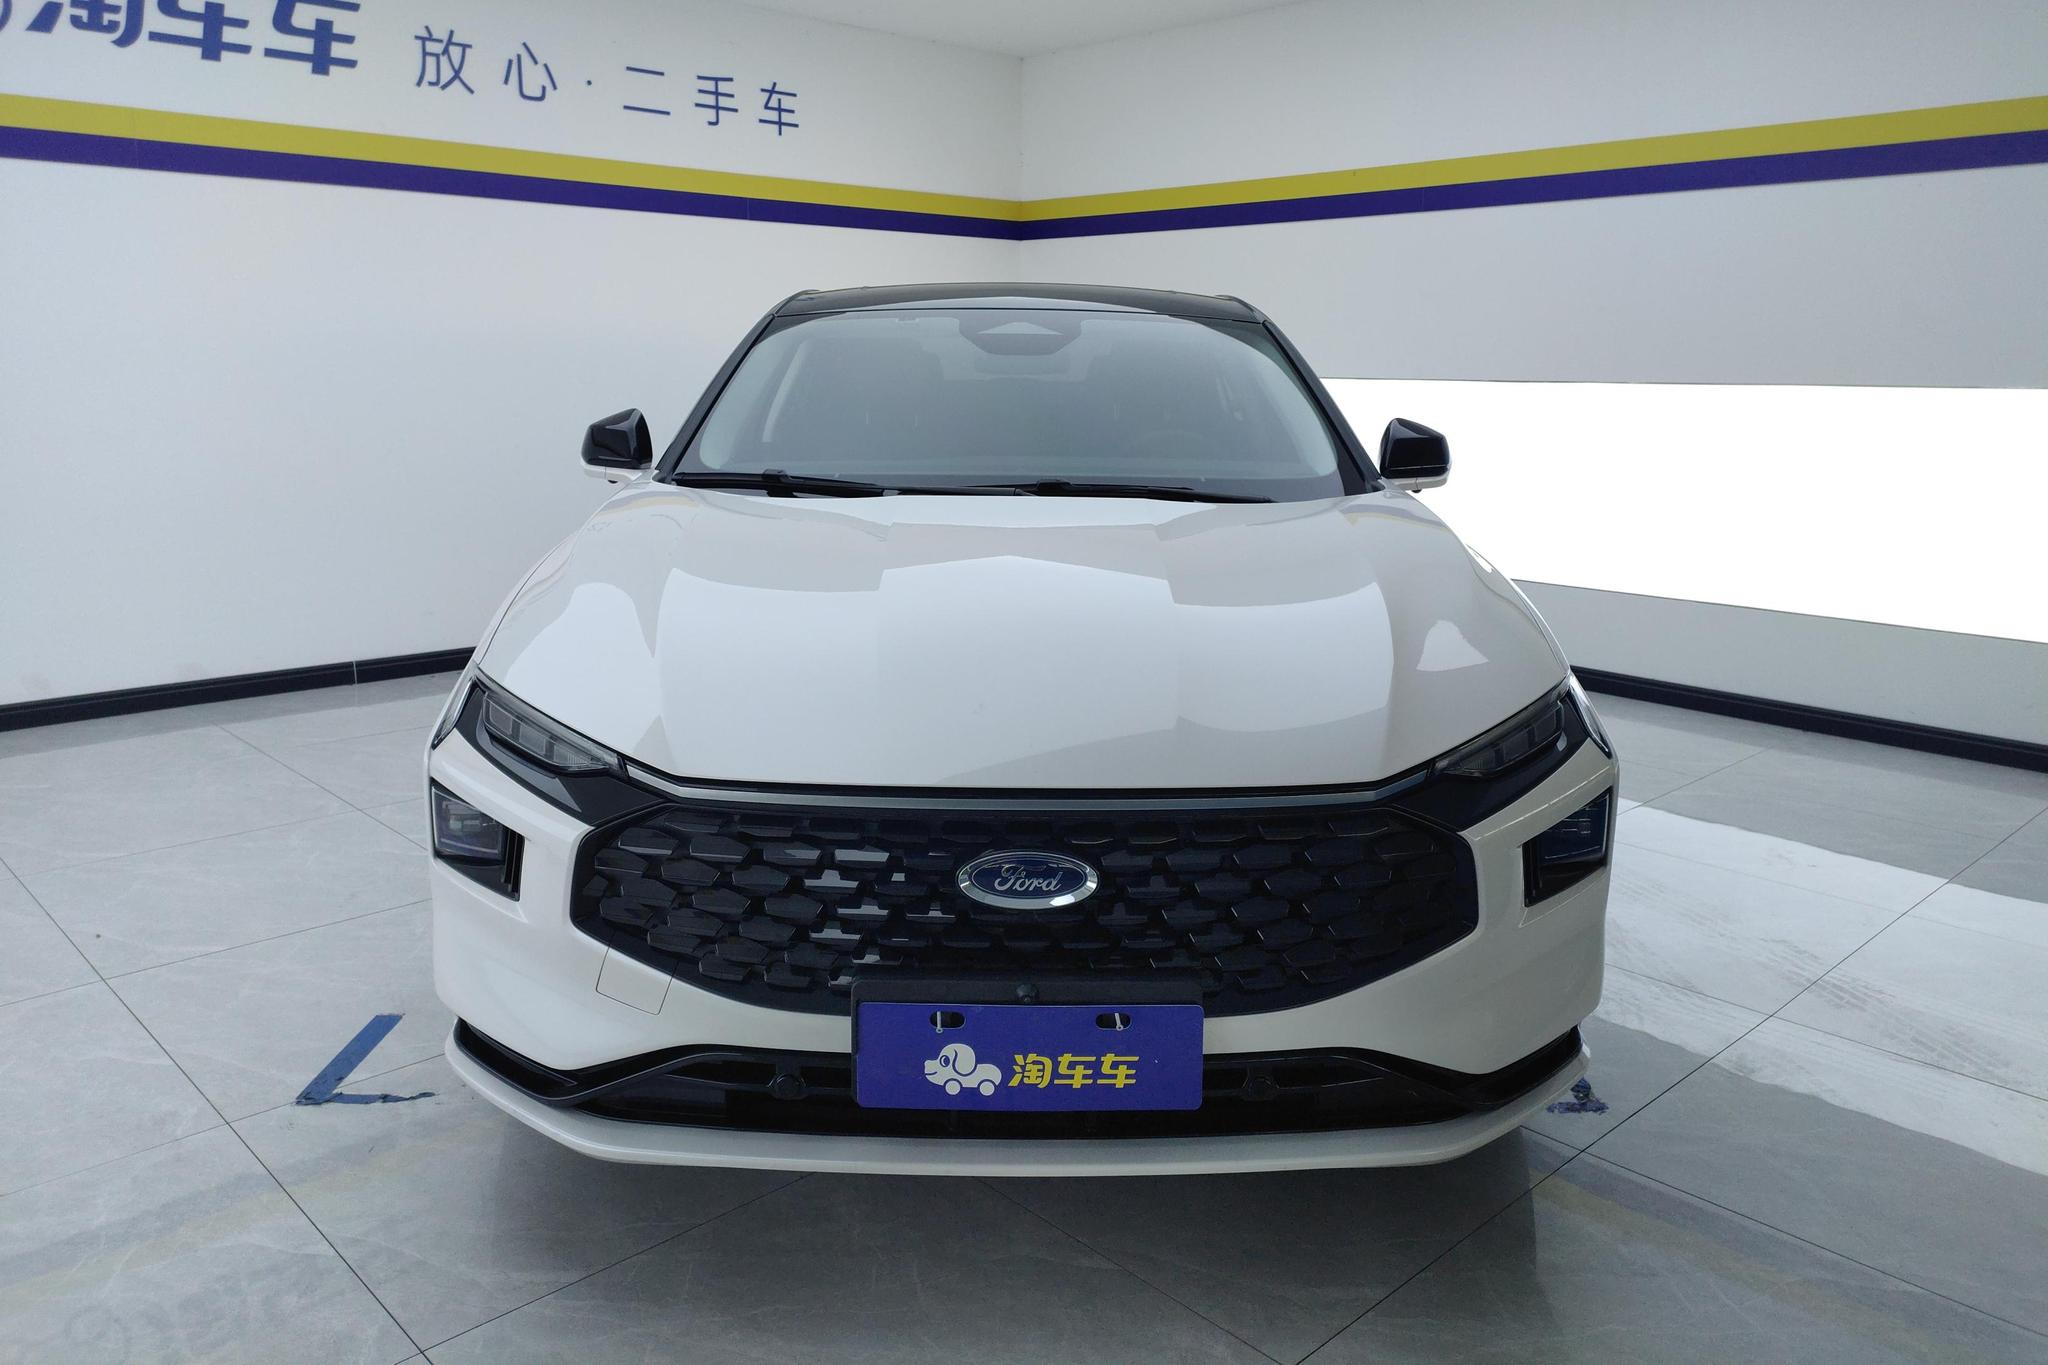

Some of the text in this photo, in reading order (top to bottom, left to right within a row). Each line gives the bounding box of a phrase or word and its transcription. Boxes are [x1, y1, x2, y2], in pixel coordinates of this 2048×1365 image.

[994, 863, 1063, 892] Ford
[1007, 1053, 1140, 1089] 淘车车
